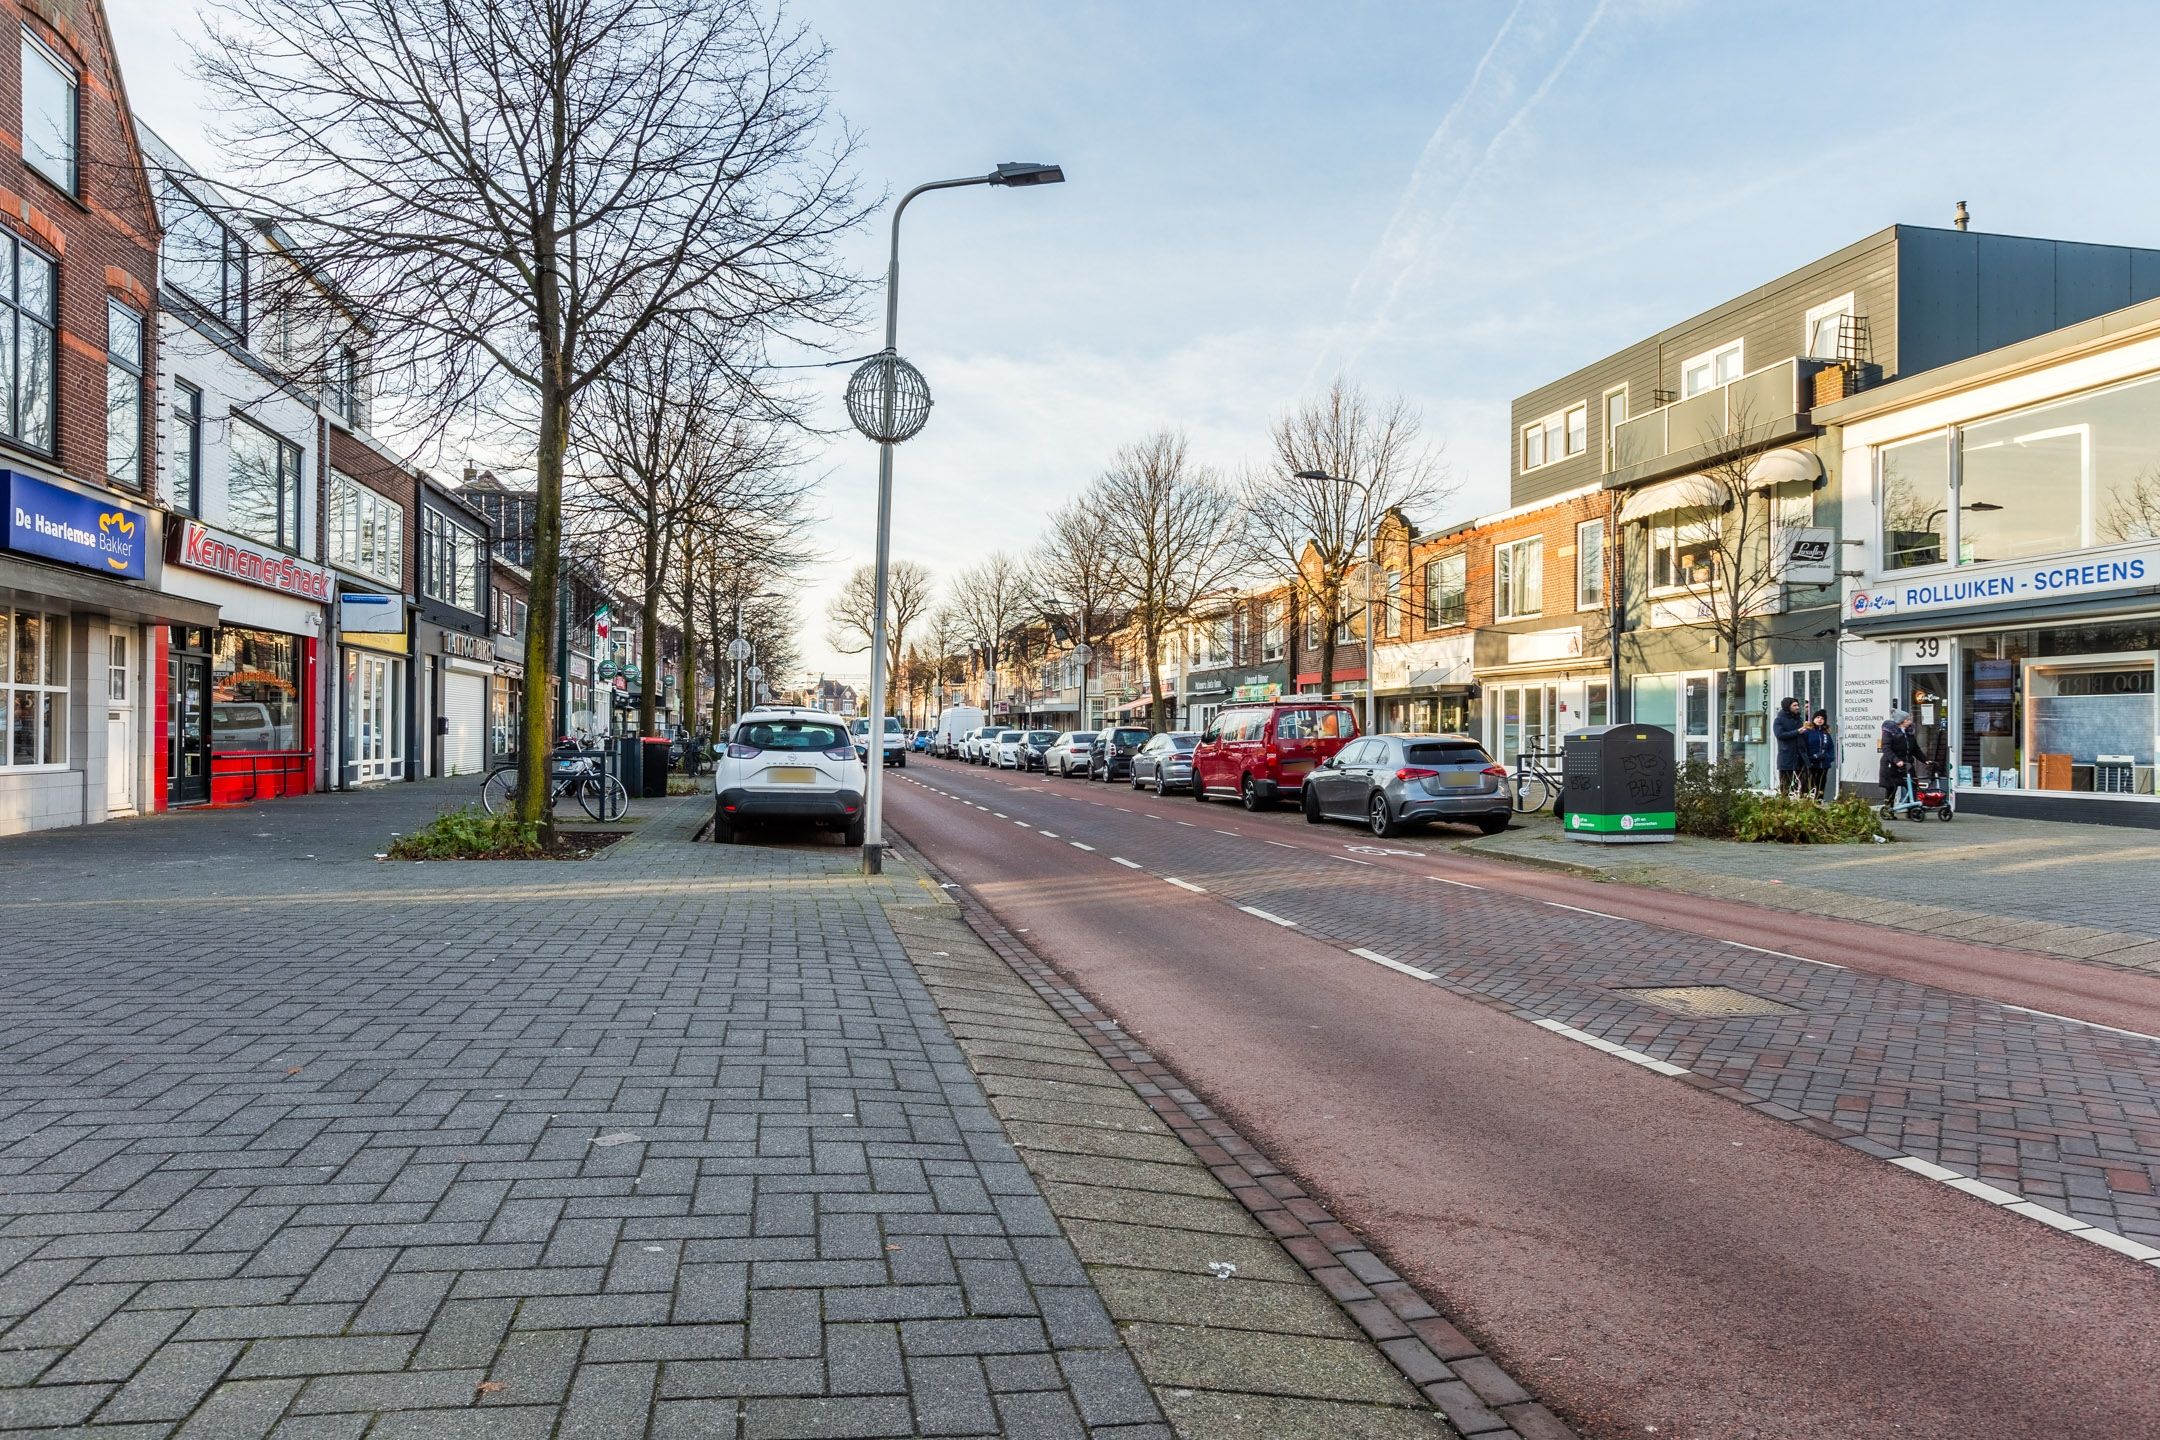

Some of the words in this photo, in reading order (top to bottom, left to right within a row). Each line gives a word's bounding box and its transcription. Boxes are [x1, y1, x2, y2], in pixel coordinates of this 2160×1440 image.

[15, 507, 32, 530] De
[35, 513, 96, 548] Haarlemse
[99, 532, 133, 557] Bakker
[1906, 576, 2014, 606] ROLLUIKEN
[2034, 559, 2145, 591] SCREENS
[1915, 637, 1940, 659] 39
